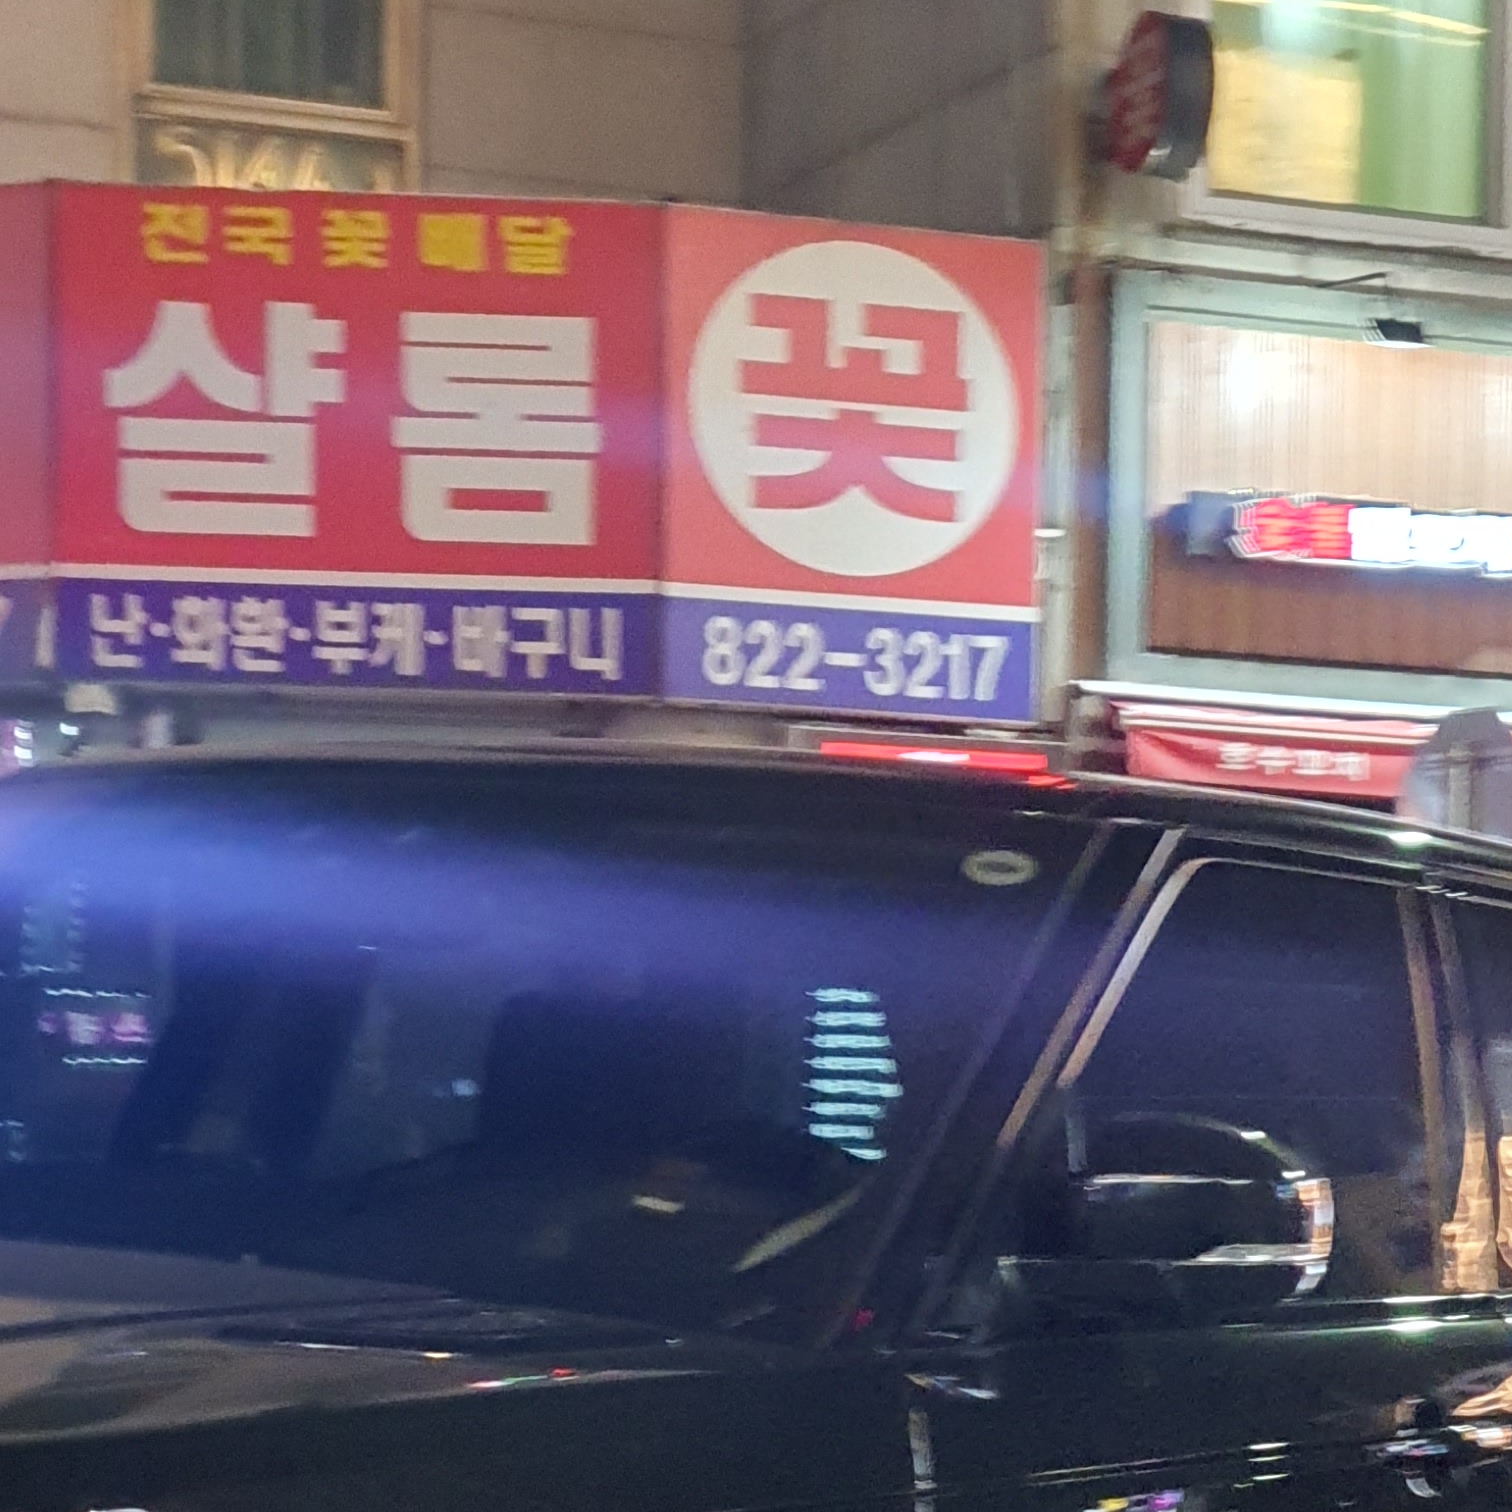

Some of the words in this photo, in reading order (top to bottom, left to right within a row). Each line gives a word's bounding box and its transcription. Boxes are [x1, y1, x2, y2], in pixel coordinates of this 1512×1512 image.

[140, 201, 295, 266] 전국
[319, 207, 391, 270] 꽃
[417, 211, 574, 277] 배달
[103, 299, 603, 546] 샬롬
[739, 291, 971, 525] 꽃
[702, 615, 1013, 702] 822-3217
